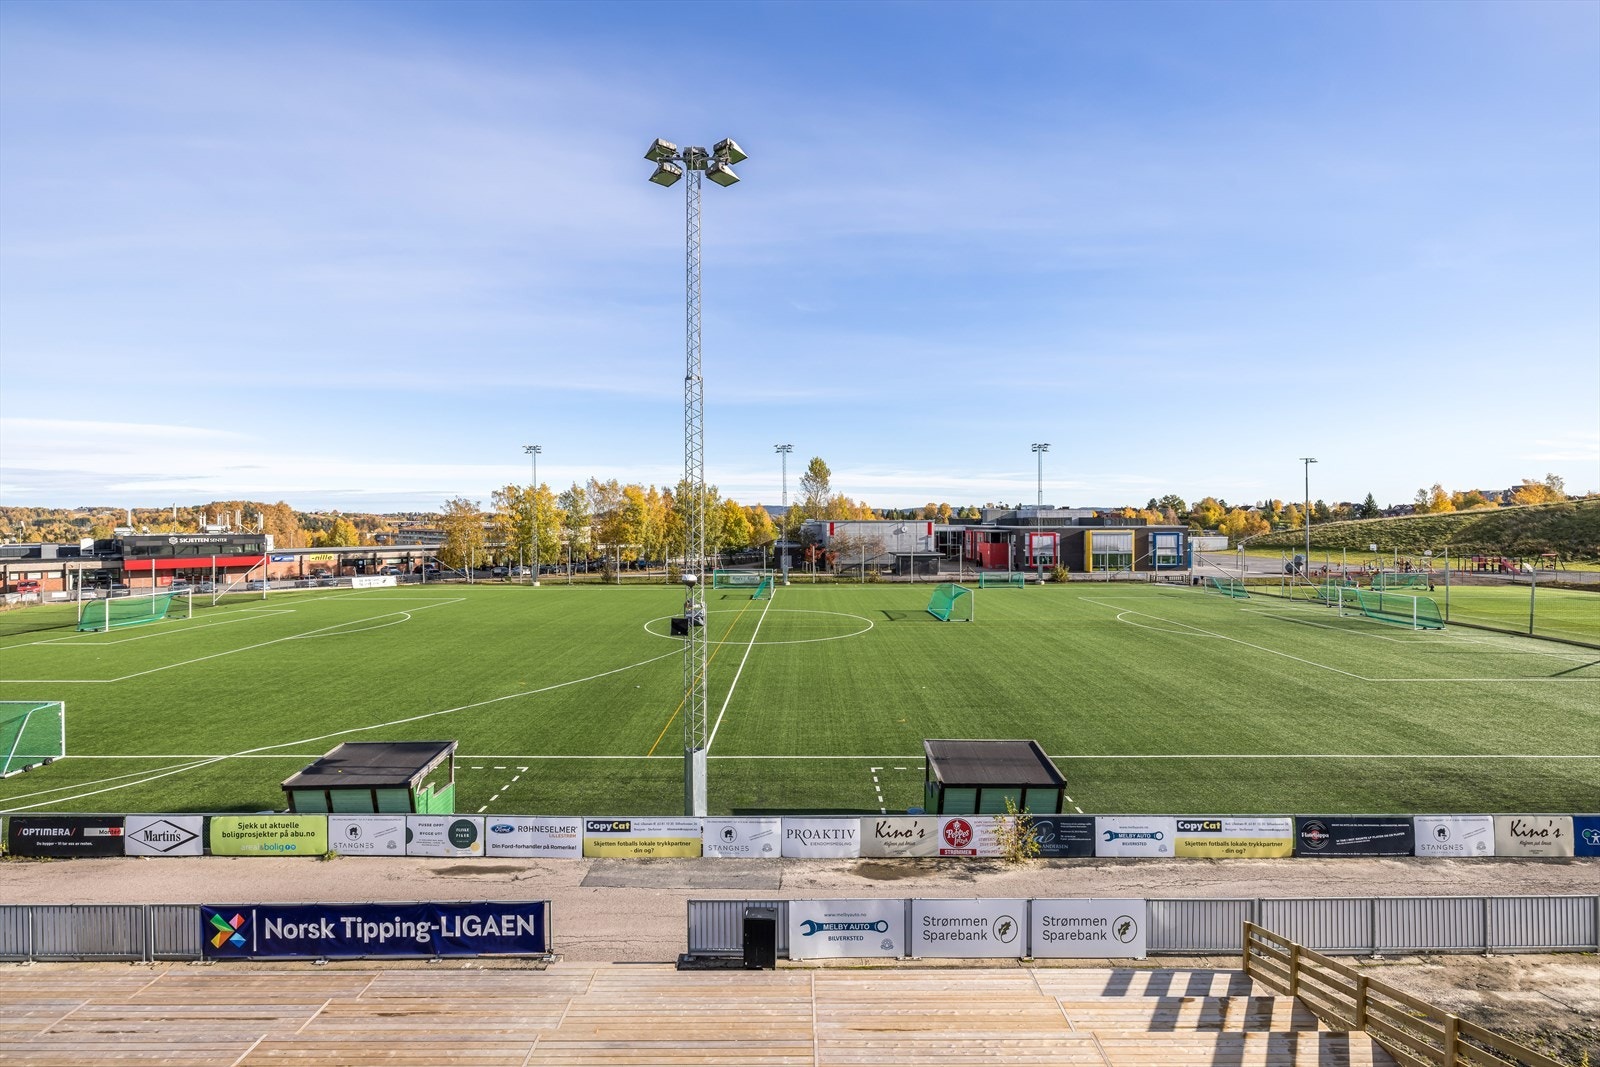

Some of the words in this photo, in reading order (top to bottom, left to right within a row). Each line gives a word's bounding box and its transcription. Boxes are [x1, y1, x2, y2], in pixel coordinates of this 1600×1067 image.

[238, 822, 258, 830] Sjekk
[494, 825, 511, 833] Ford
[518, 825, 577, 833] RØHNESELMER
[587, 822, 630, 831] CopyCat
[875, 821, 925, 838] Kino's
[1178, 821, 1221, 832] CopyCat
[1511, 820, 1561, 838] Kino's
[143, 829, 181, 842] Martin's
[222, 829, 278, 839] boligprosjekter
[280, 830, 289, 838] på
[291, 830, 315, 838] abu.no
[787, 829, 855, 846] PROAKTIV
[657, 840, 691, 848] trykkpartner
[708, 844, 750, 852] STANGNES
[923, 916, 988, 927] Strømmen
[1042, 916, 1107, 927] Strømmen
[265, 917, 336, 939] Norsk
[340, 914, 535, 943] Tipping-LIGAEN
[923, 930, 988, 943] Sparebank
[1042, 930, 1107, 943] Sparebank
